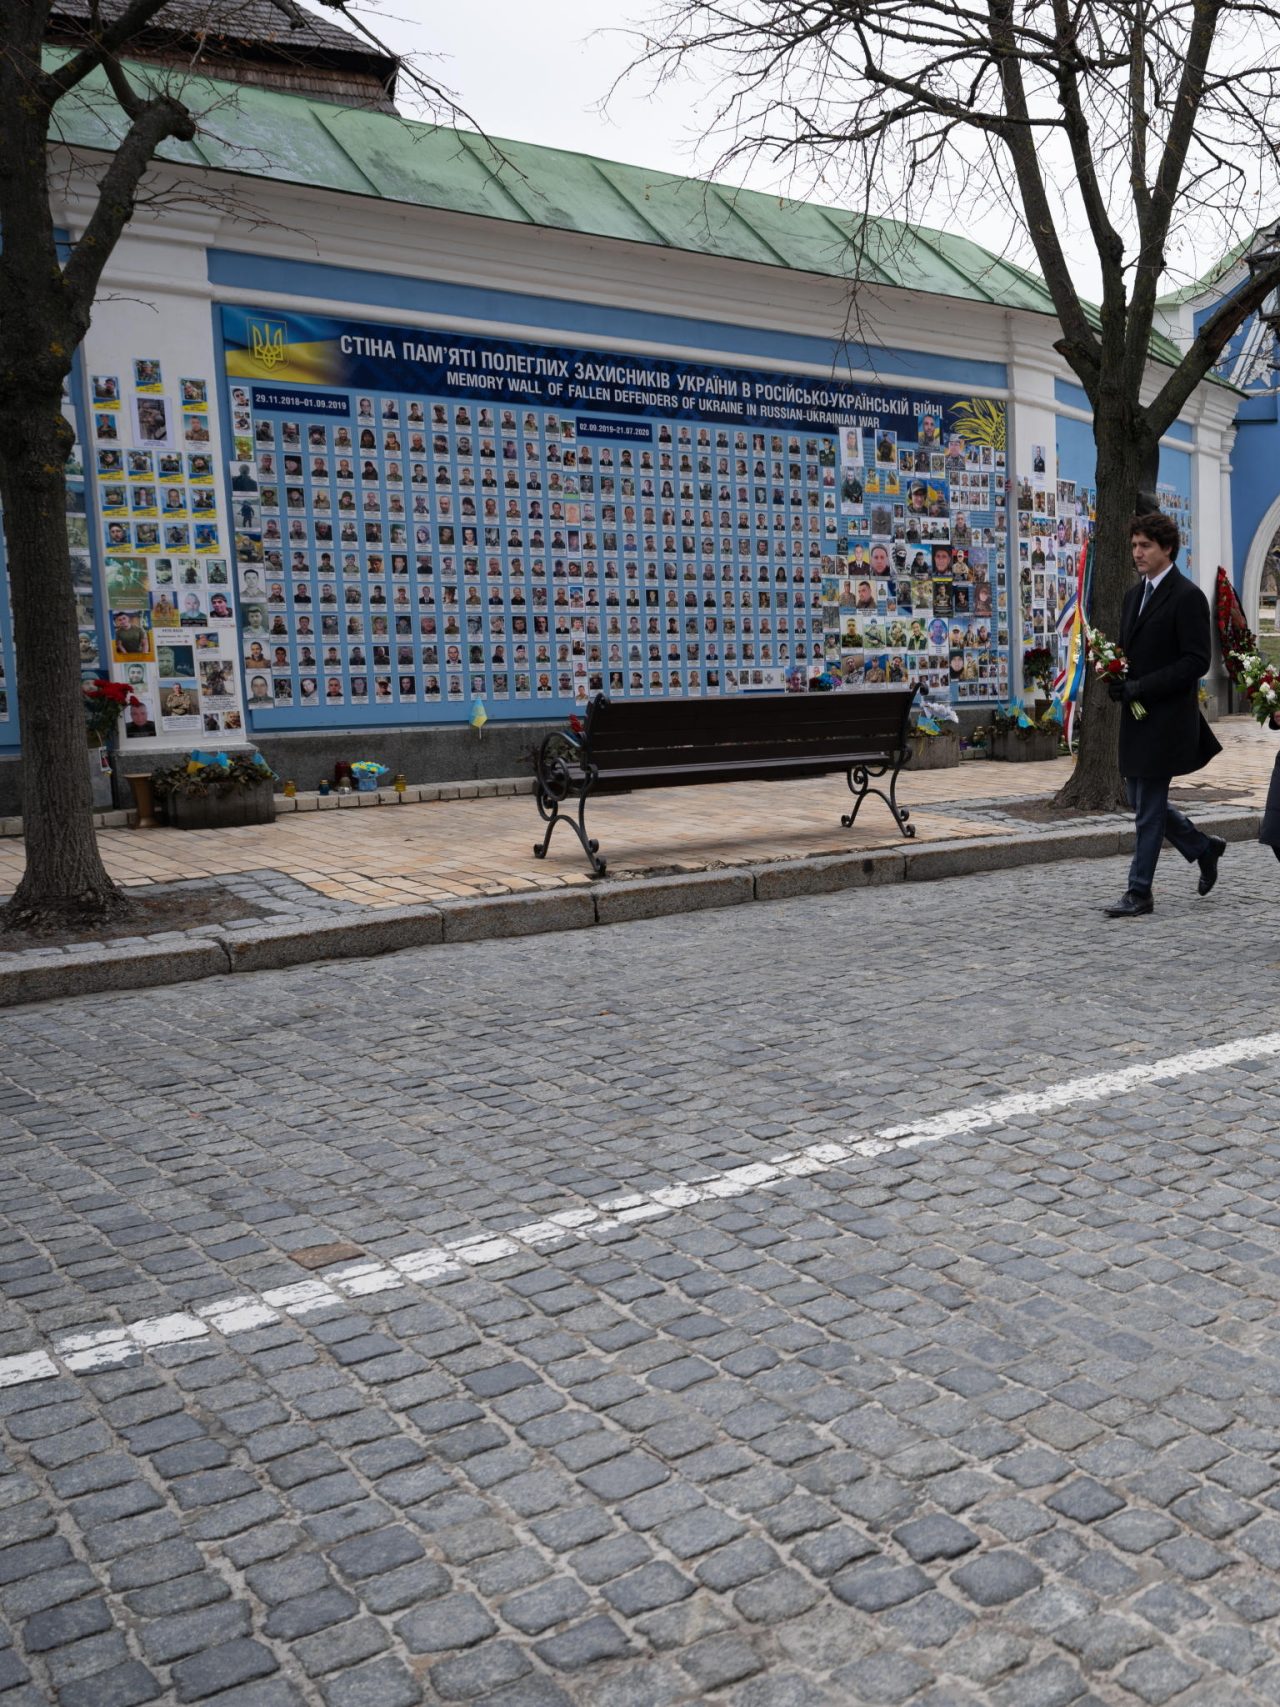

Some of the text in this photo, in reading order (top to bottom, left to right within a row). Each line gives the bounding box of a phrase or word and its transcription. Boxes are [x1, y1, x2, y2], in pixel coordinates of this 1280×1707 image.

[340, 335, 396, 359] СТІНА
[481, 351, 569, 378] ПОЛЕГЛИХ
[574, 362, 670, 389] ЗАХИСНИКІВ
[677, 373, 738, 398] УКРАЇНИ
[742, 382, 751, 398] В
[755, 384, 909, 416] РОСІЙСЬКО-УКРАЇНСЬКІЙ
[447, 371, 880, 429] MEMORY WALL OF FALLEN DEFENDERS OF UKRAINE IN RUSSIAN-UKRAINIAN WAR
